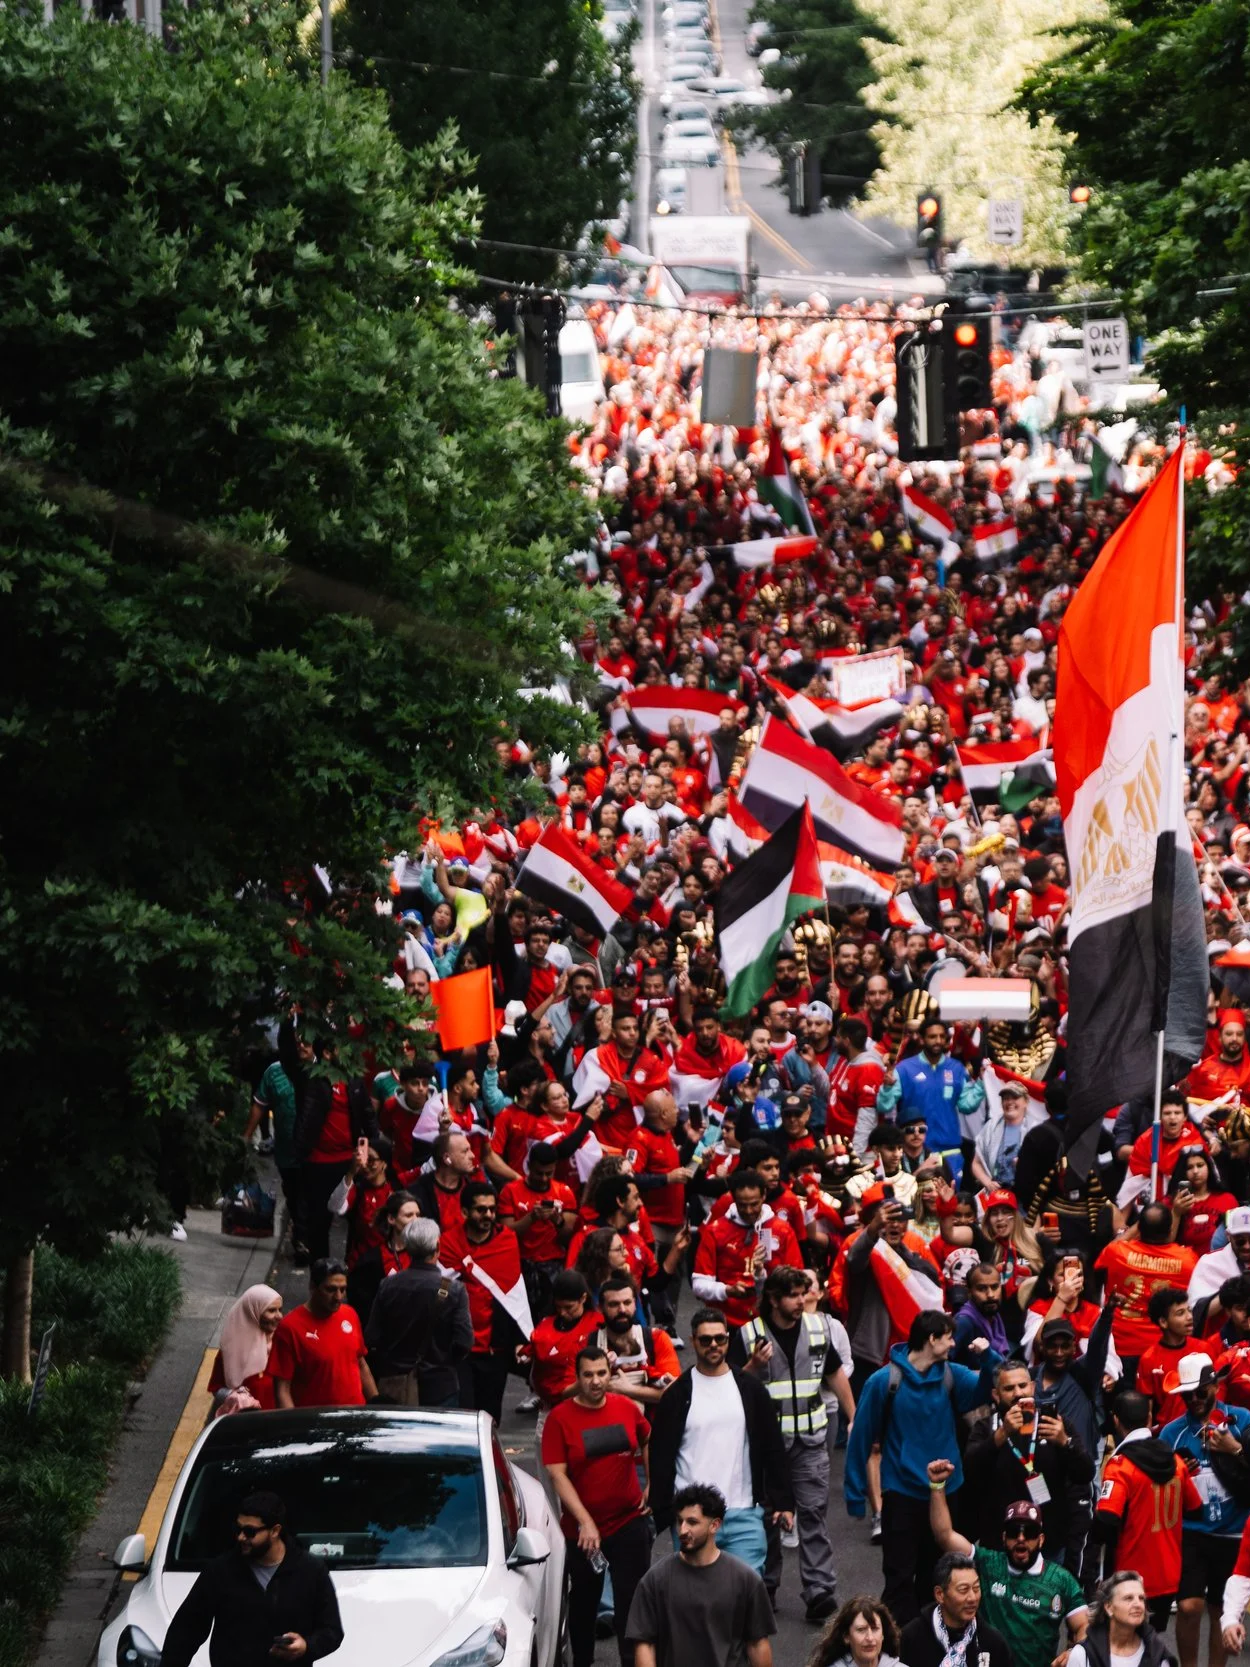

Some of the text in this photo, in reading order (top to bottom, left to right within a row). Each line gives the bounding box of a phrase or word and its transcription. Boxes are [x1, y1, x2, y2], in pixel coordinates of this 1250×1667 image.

[1089, 324, 1121, 340] ONE
[1089, 342, 1123, 357] WAY
[1242, 1214, 1250, 1224] T
[1126, 1251, 1183, 1273] MARMOUSH
[1151, 1478, 1182, 1533] 10
[1012, 1593, 1041, 1609] MEXICO
